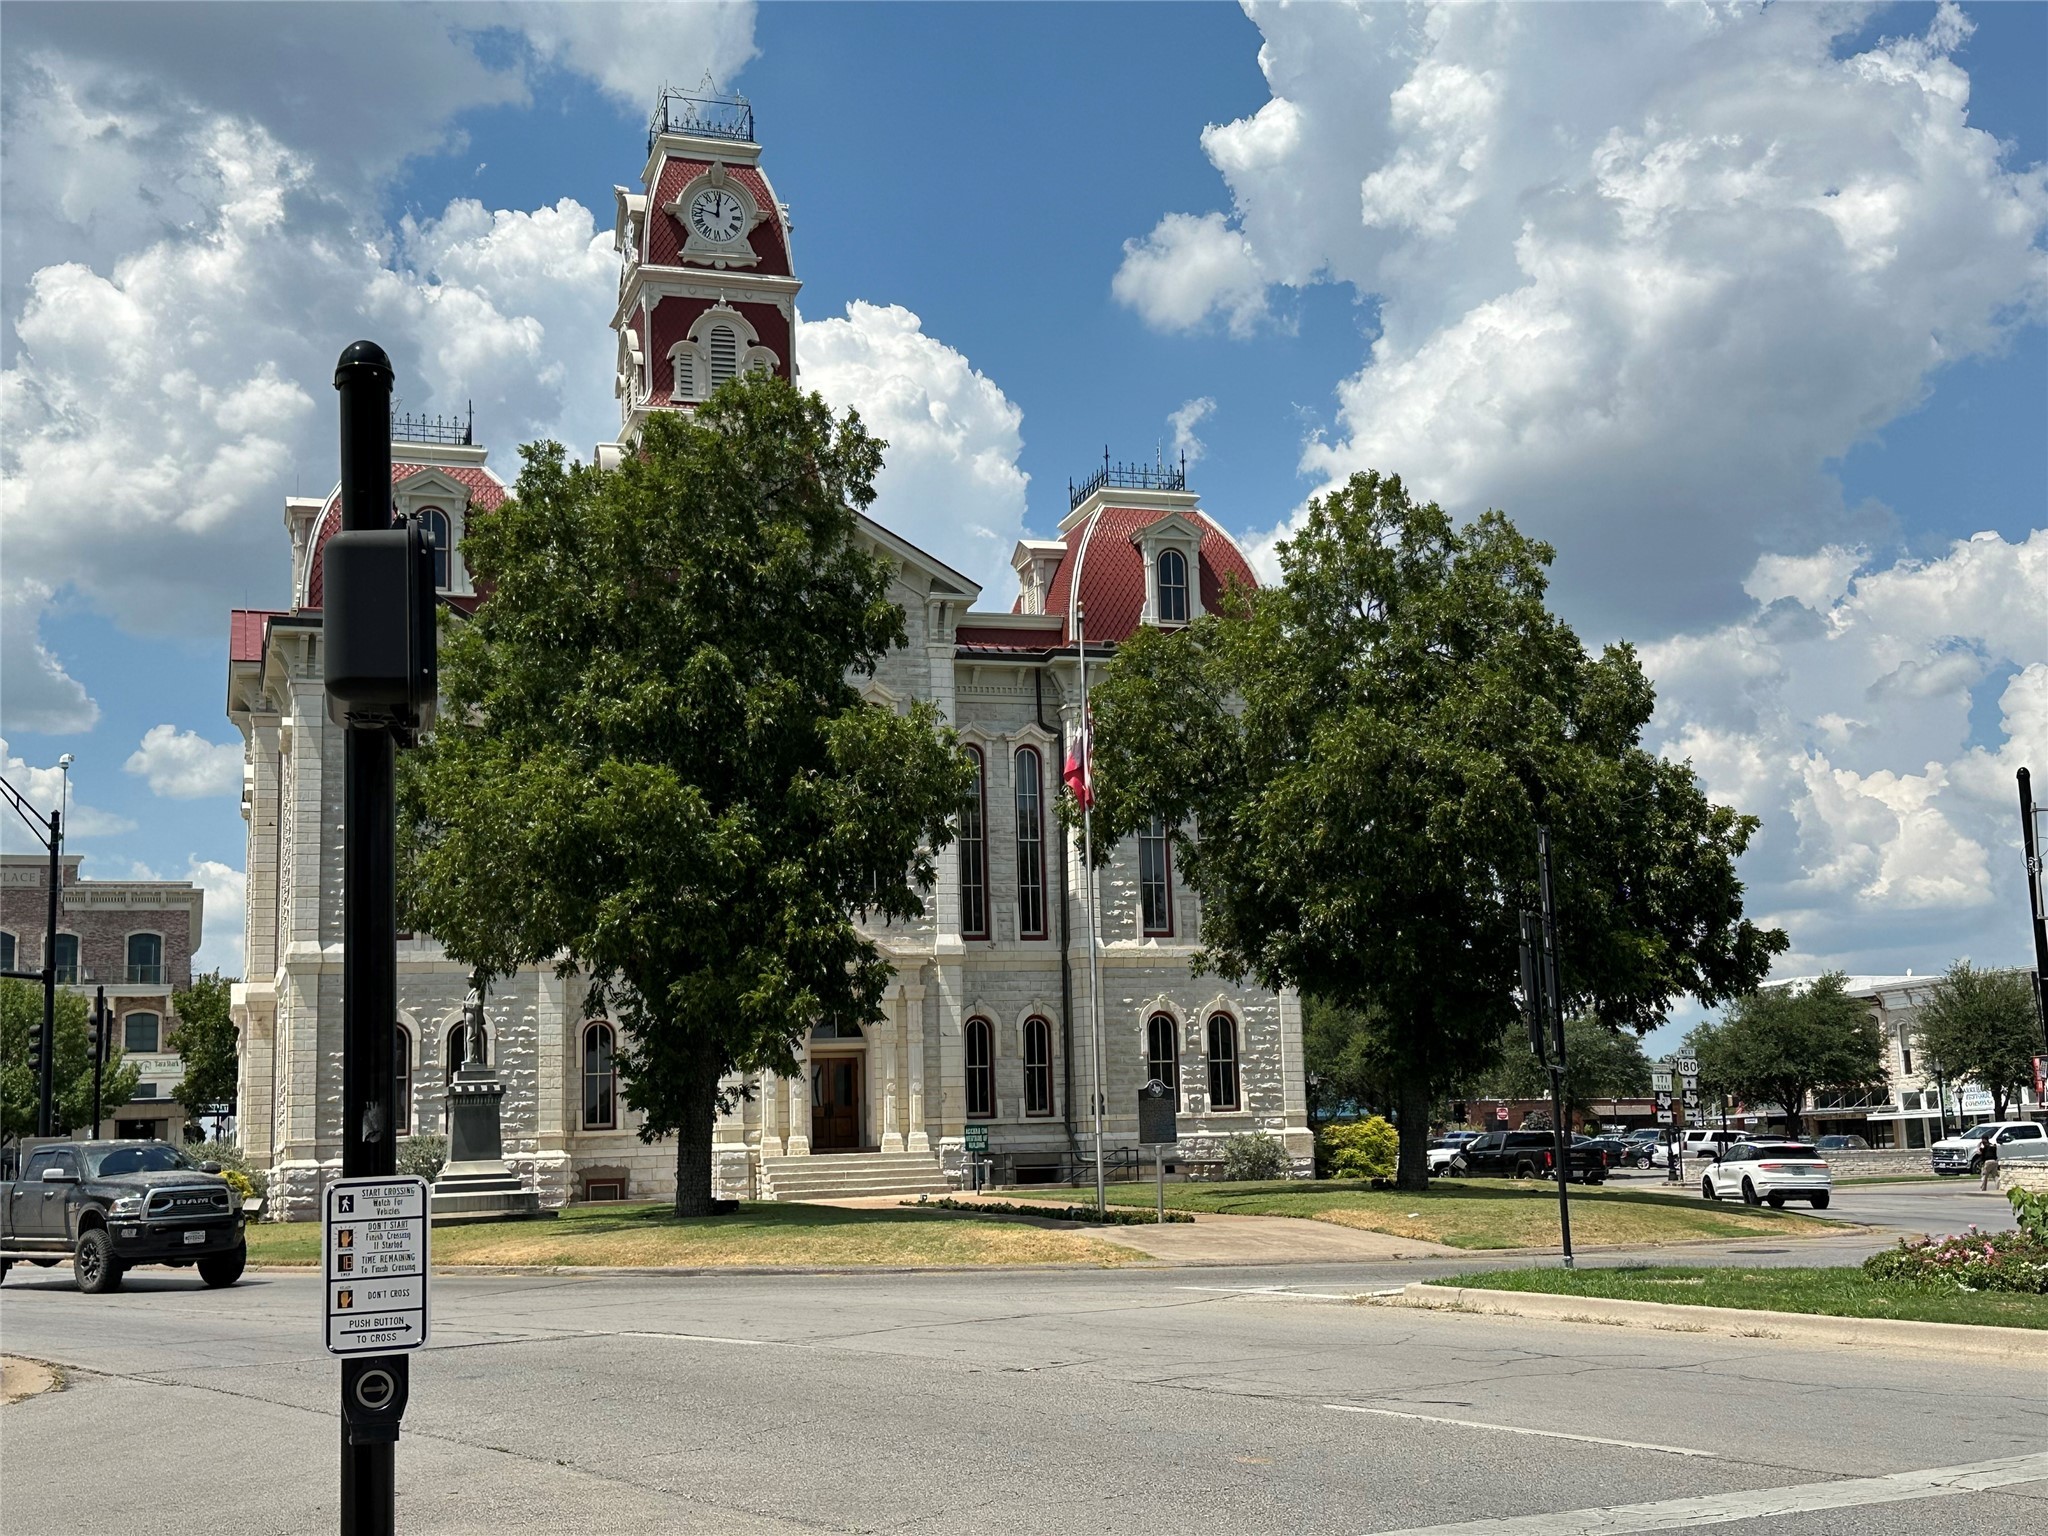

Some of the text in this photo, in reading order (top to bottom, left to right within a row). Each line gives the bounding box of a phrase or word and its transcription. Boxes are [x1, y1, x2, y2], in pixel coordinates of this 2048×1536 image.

[0, 872, 36, 882] LACE
[1679, 1061, 1697, 1072] 180
[362, 1187, 415, 1197] START CROSSING
[373, 1198, 403, 1207] Watch for
[377, 1208, 400, 1216] Vehicles
[368, 1220, 408, 1230] DON'T START
[366, 1231, 411, 1241] Finish Crossing
[374, 1240, 403, 1250] If Started
[362, 1253, 415, 1264] TIME REMAINING
[361, 1263, 415, 1274] To Finish Crossing
[367, 1288, 410, 1299] DON'T CROSS
[349, 1316, 404, 1328] PUSH BUTTON
[357, 1333, 397, 1343] TO CROSS
